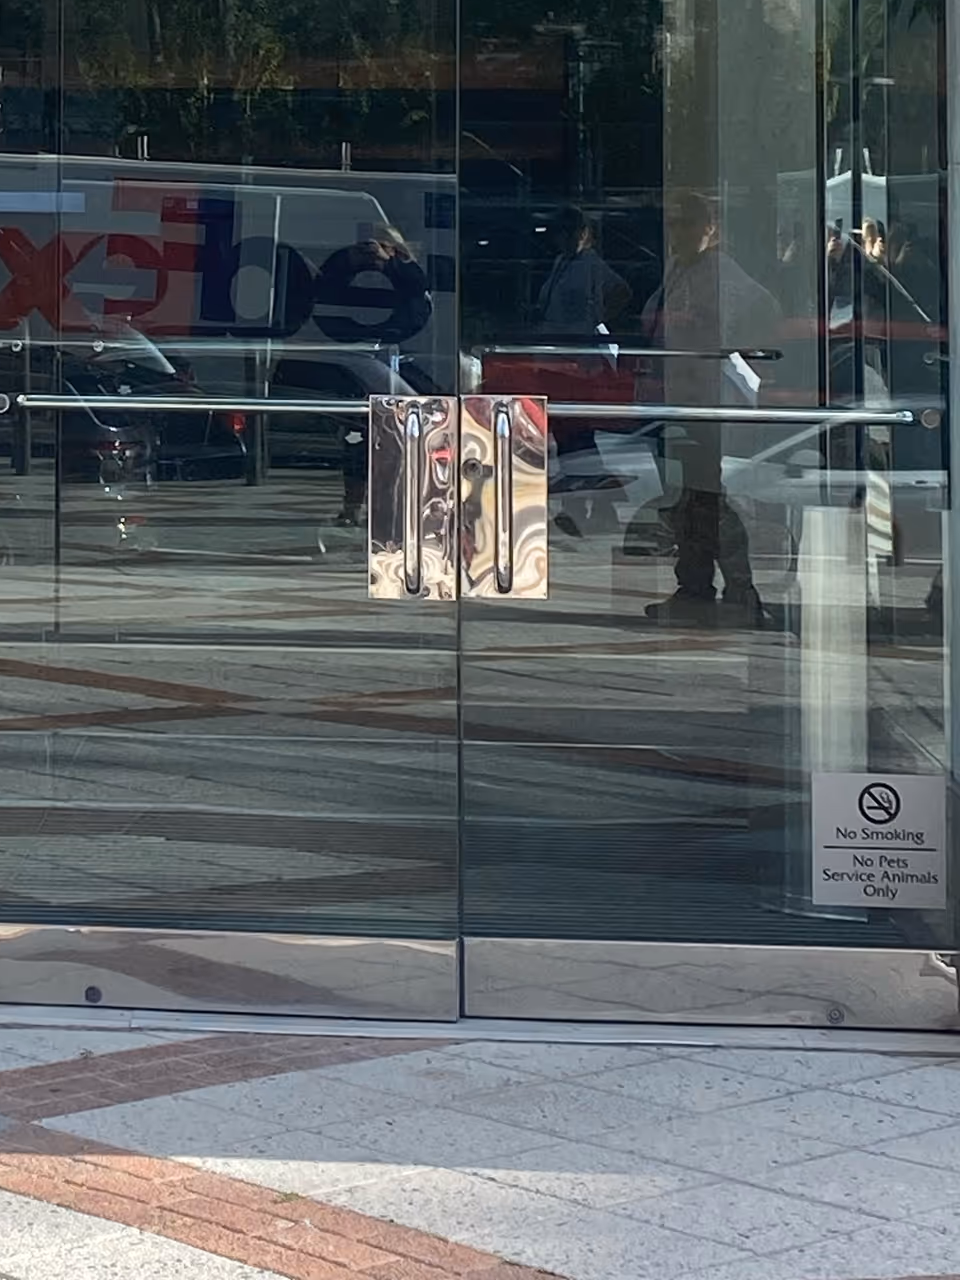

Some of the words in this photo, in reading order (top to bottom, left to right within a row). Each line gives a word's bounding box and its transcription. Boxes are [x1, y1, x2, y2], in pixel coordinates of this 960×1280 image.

[835, 826, 857, 840] No
[861, 827, 925, 846] Smoking
[852, 853, 874, 868] No
[879, 855, 908, 869] Pets
[822, 868, 876, 883] Service
[880, 870, 939, 885] Animals
[862, 883, 898, 901] Only
